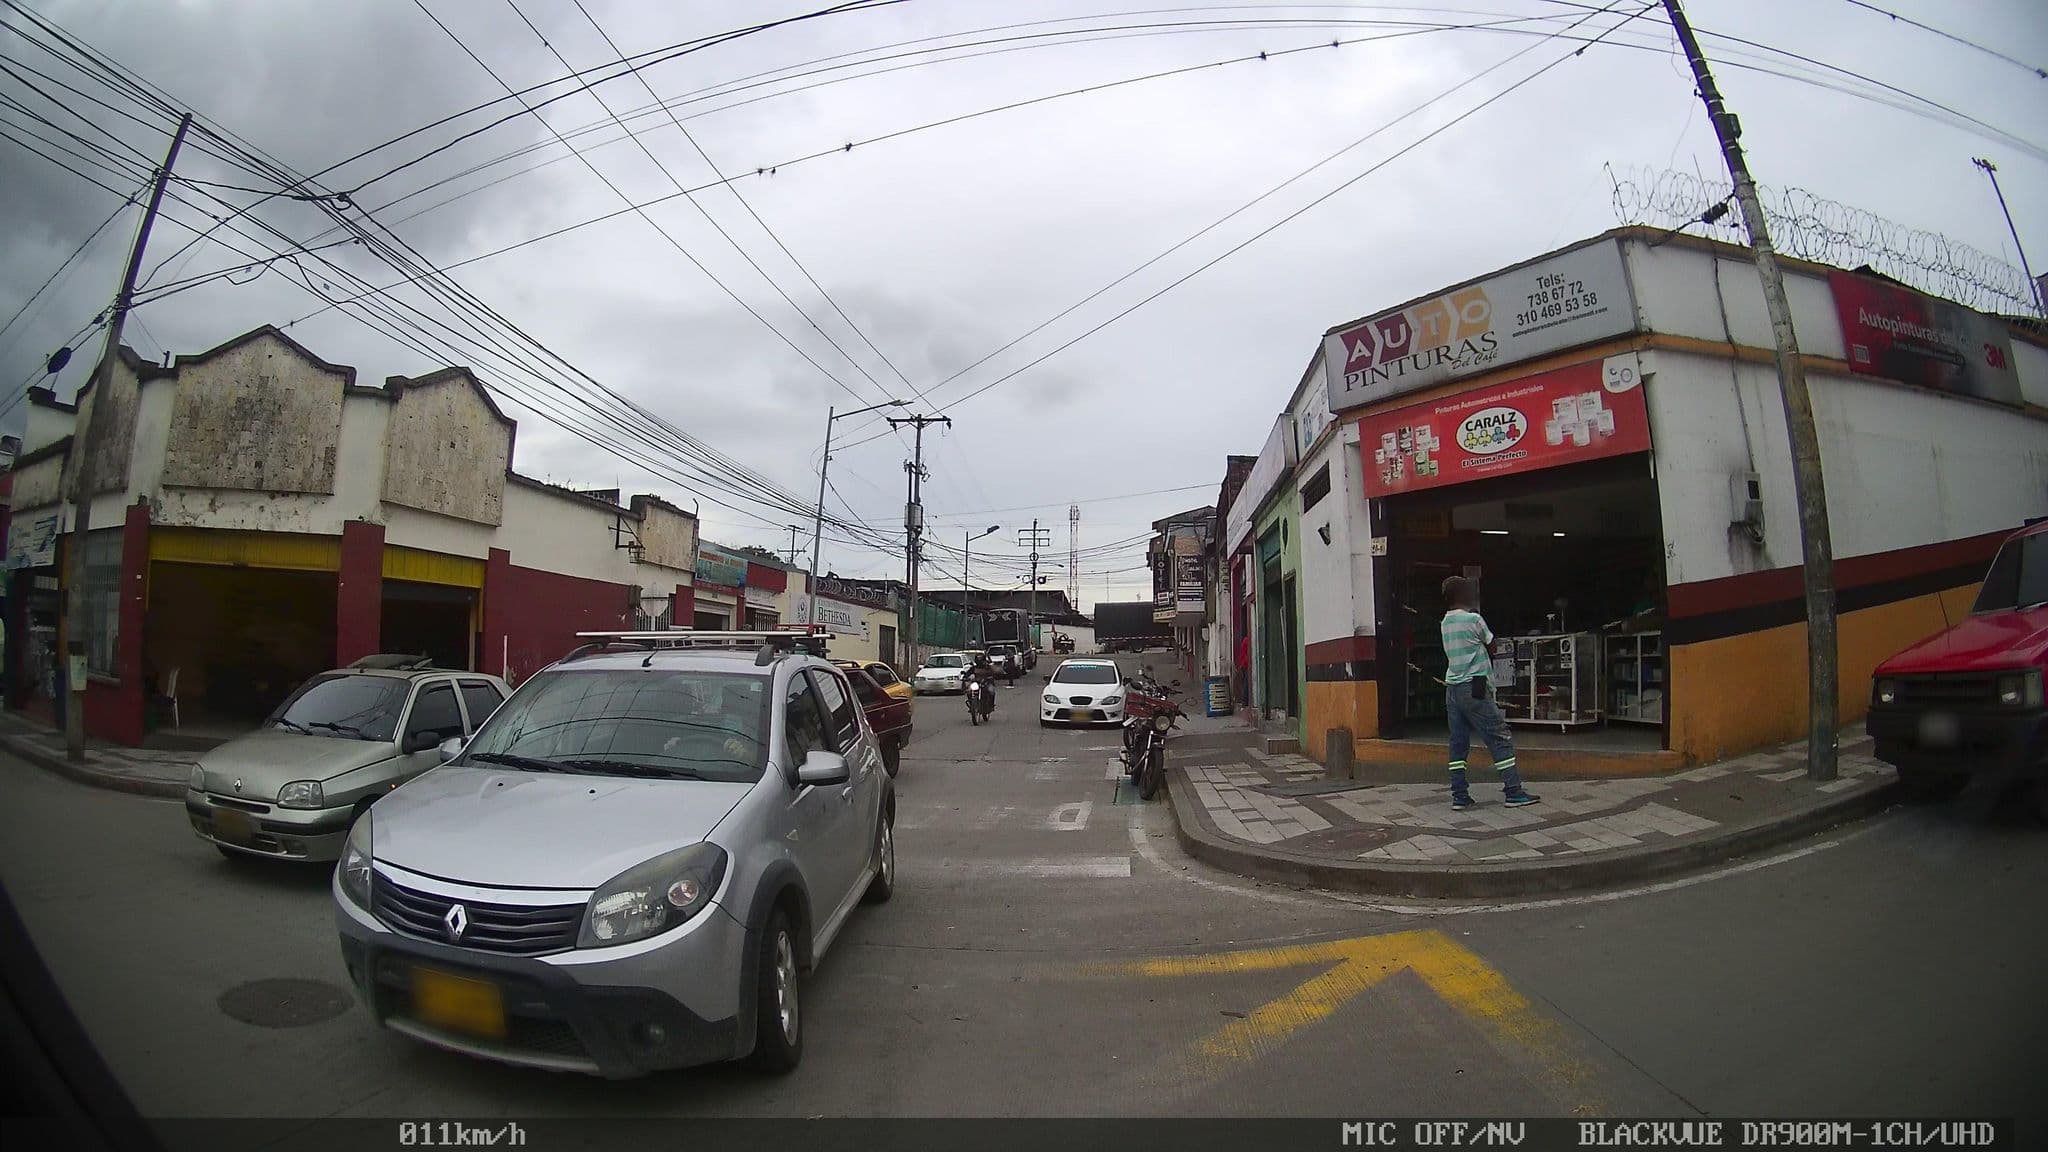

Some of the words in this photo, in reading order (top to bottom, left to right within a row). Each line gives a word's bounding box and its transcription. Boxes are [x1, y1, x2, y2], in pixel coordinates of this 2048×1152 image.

[1528, 291, 1549, 308] 738
[1552, 286, 1565, 300] 67
[1569, 280, 1584, 295] 72
[1536, 273, 1565, 289] Tels:
[1517, 310, 1538, 326] 310
[1541, 302, 1562, 319] 469
[1565, 297, 1579, 312] 53
[1583, 292, 1597, 307] 58
[1350, 300, 1487, 363] AUTO
[1859, 306, 1939, 343] Autopinturas
[1344, 331, 1498, 393] PINTURAS
[1452, 358, 1471, 370] Del
[1465, 412, 1517, 431] CARALZ
[1471, 456, 1496, 465] Sistema
[1498, 451, 1527, 461] Perfecto
